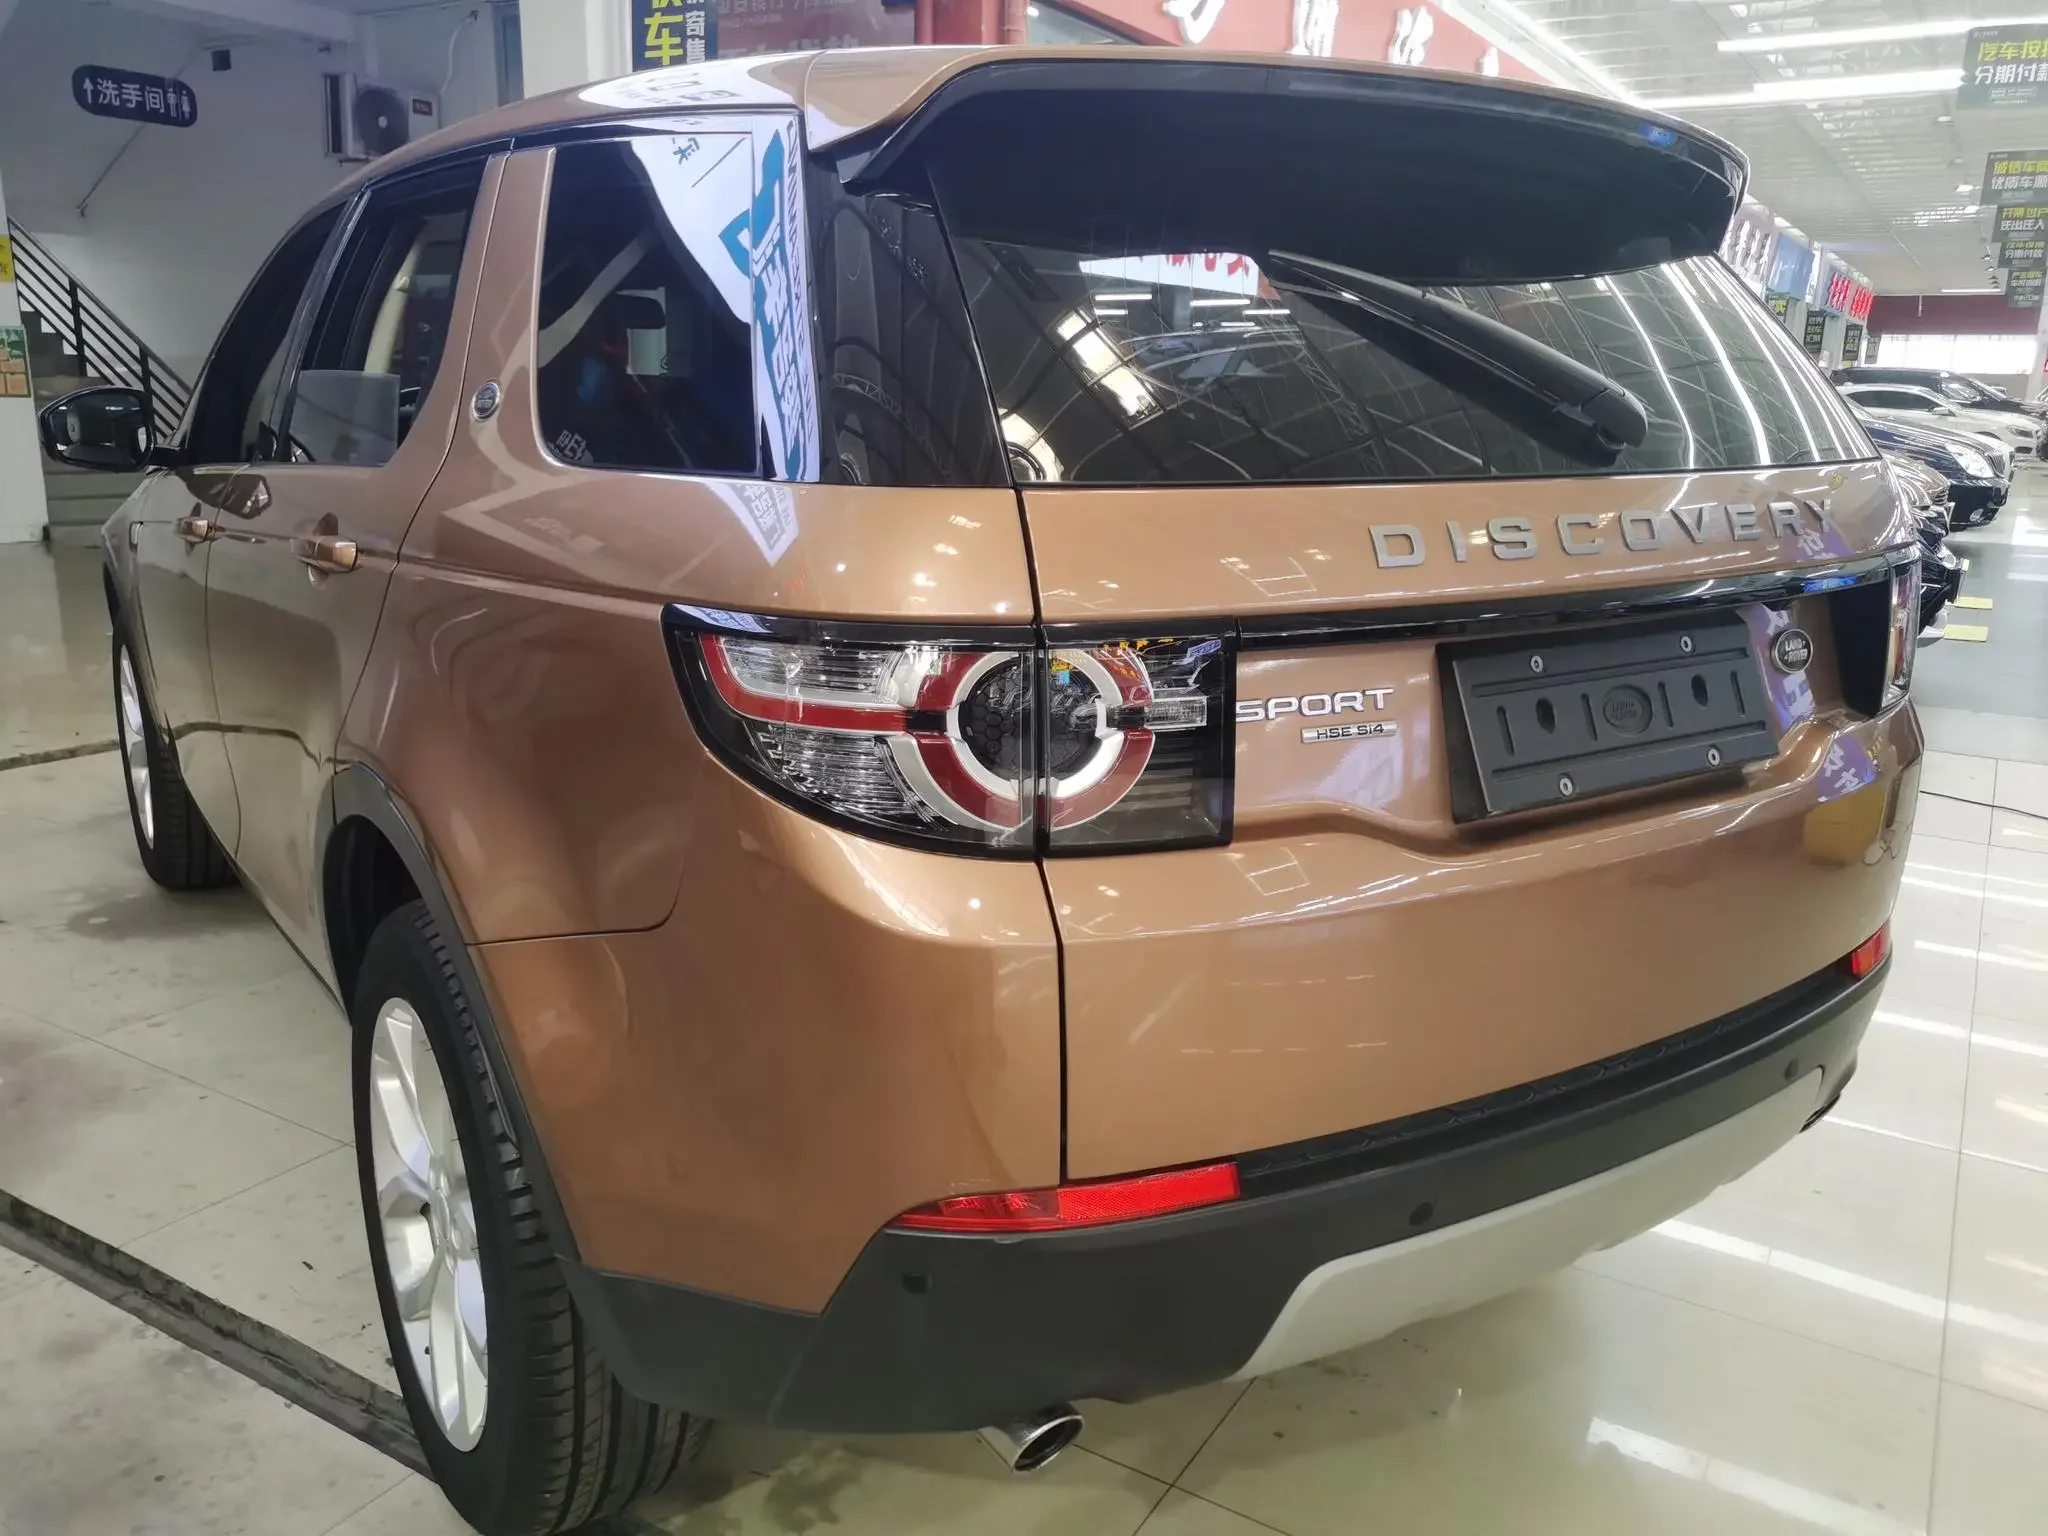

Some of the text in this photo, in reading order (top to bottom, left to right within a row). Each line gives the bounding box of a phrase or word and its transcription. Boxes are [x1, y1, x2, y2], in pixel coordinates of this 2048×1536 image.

[686, 0, 706, 63] 寄售
[97, 78, 165, 113] 洗手间
[1368, 498, 1832, 569] DISCOVERY
[1236, 687, 1394, 722] SPORT
[1317, 723, 1385, 740] HSE Si4
